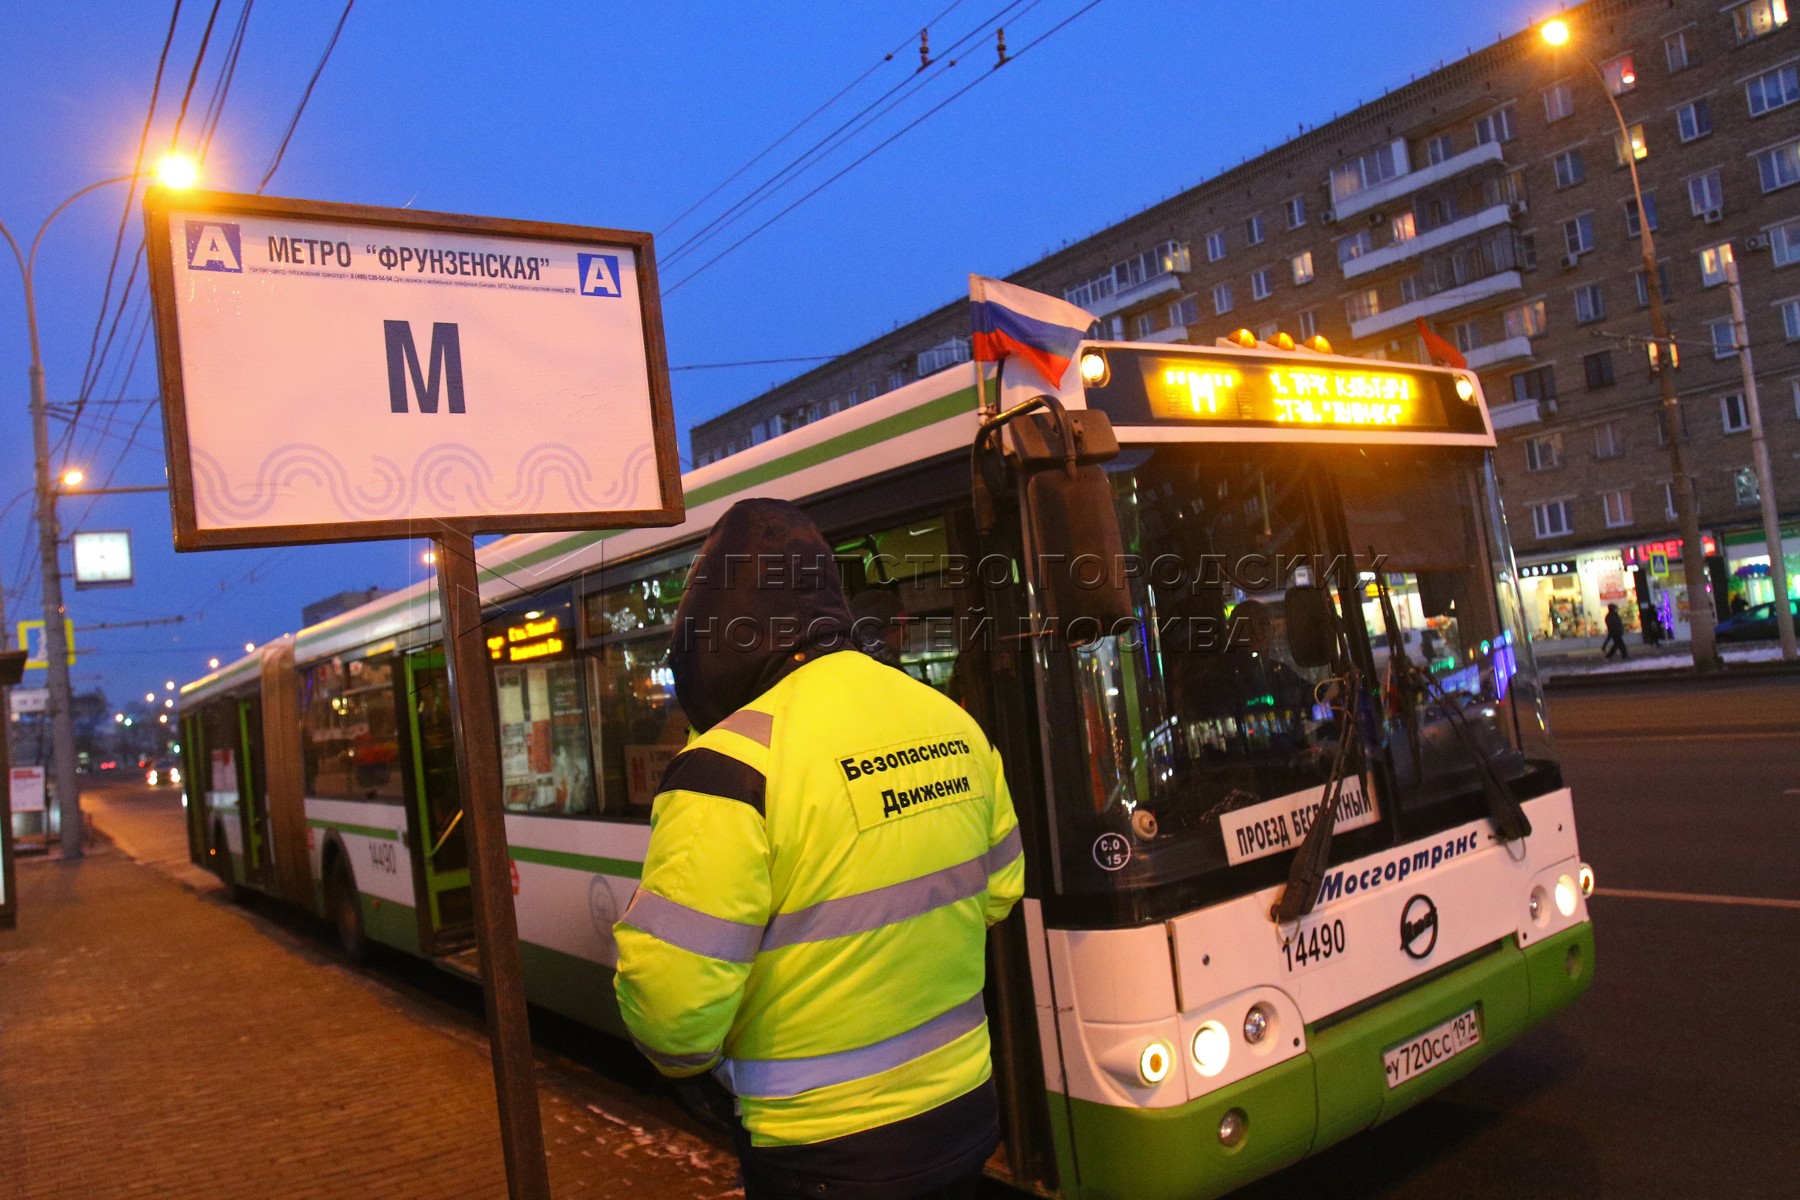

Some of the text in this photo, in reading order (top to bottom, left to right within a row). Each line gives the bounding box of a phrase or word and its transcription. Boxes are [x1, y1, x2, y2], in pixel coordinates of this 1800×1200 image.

[268, 236, 351, 268] МЕТРО
[383, 319, 466, 414] М
[840, 739, 970, 781] Безопасность
[881, 776, 971, 818] Движения
[1236, 814, 1291, 857] ПРОЕЗД
[1106, 852, 1122, 866] 15
[1317, 830, 1478, 904] Мосгортранс
[1281, 918, 1346, 973] 14490
[1453, 1013, 1472, 1040] 197
